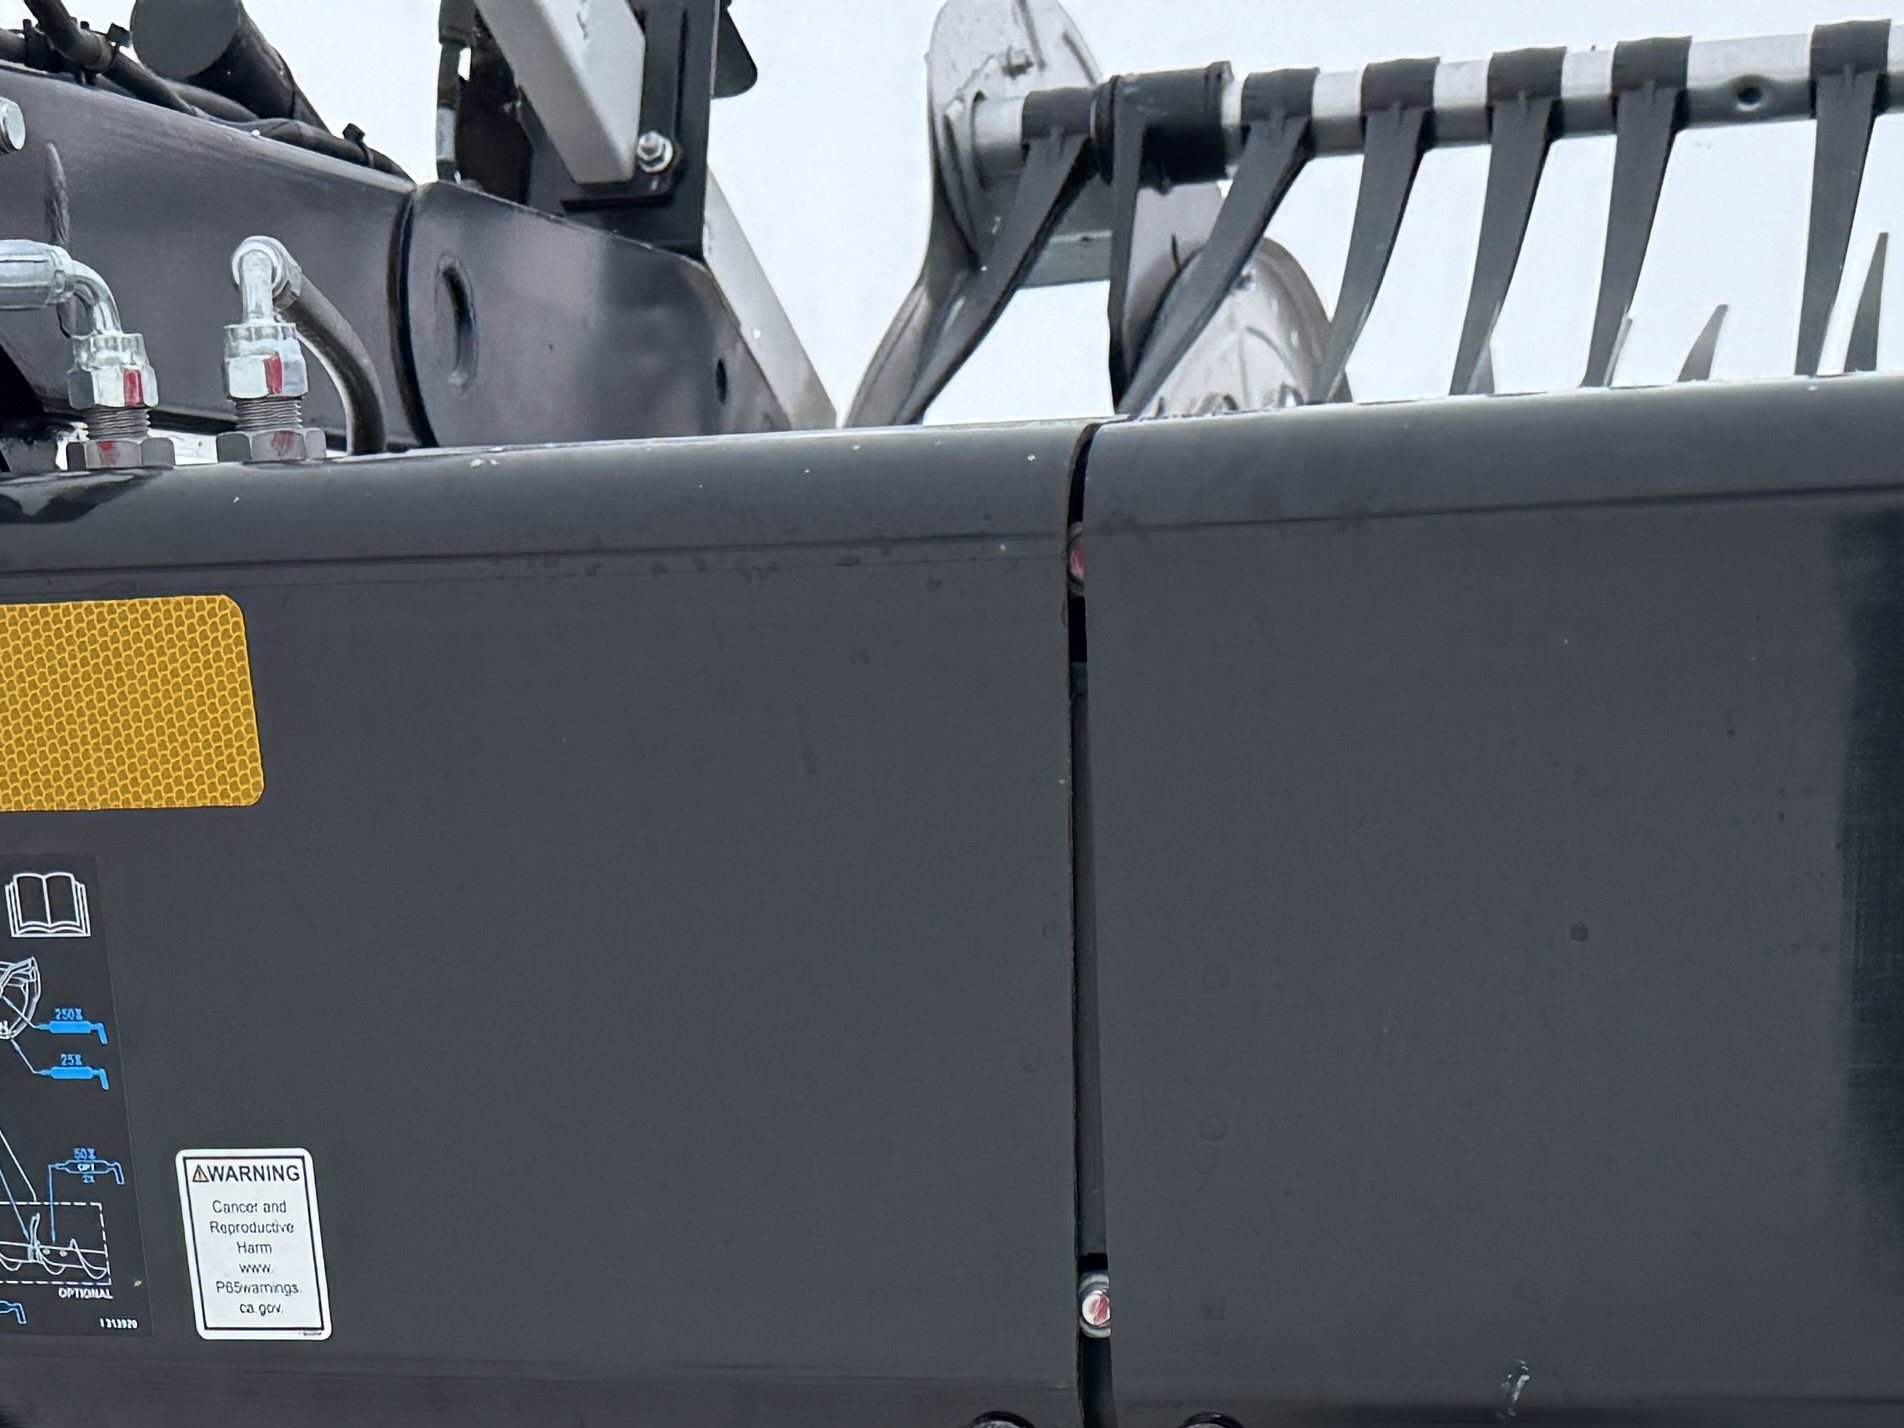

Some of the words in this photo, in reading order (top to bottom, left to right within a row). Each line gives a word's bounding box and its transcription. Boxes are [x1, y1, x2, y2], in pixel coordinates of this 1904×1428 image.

[207, 1165, 300, 1182] WARNING
[212, 1200, 258, 1213] Cancer
[263, 1200, 287, 1213] and
[209, 1221, 294, 1235] Reproductive
[237, 1241, 272, 1254] Harm
[58, 1288, 113, 1300] OPTIONAL
